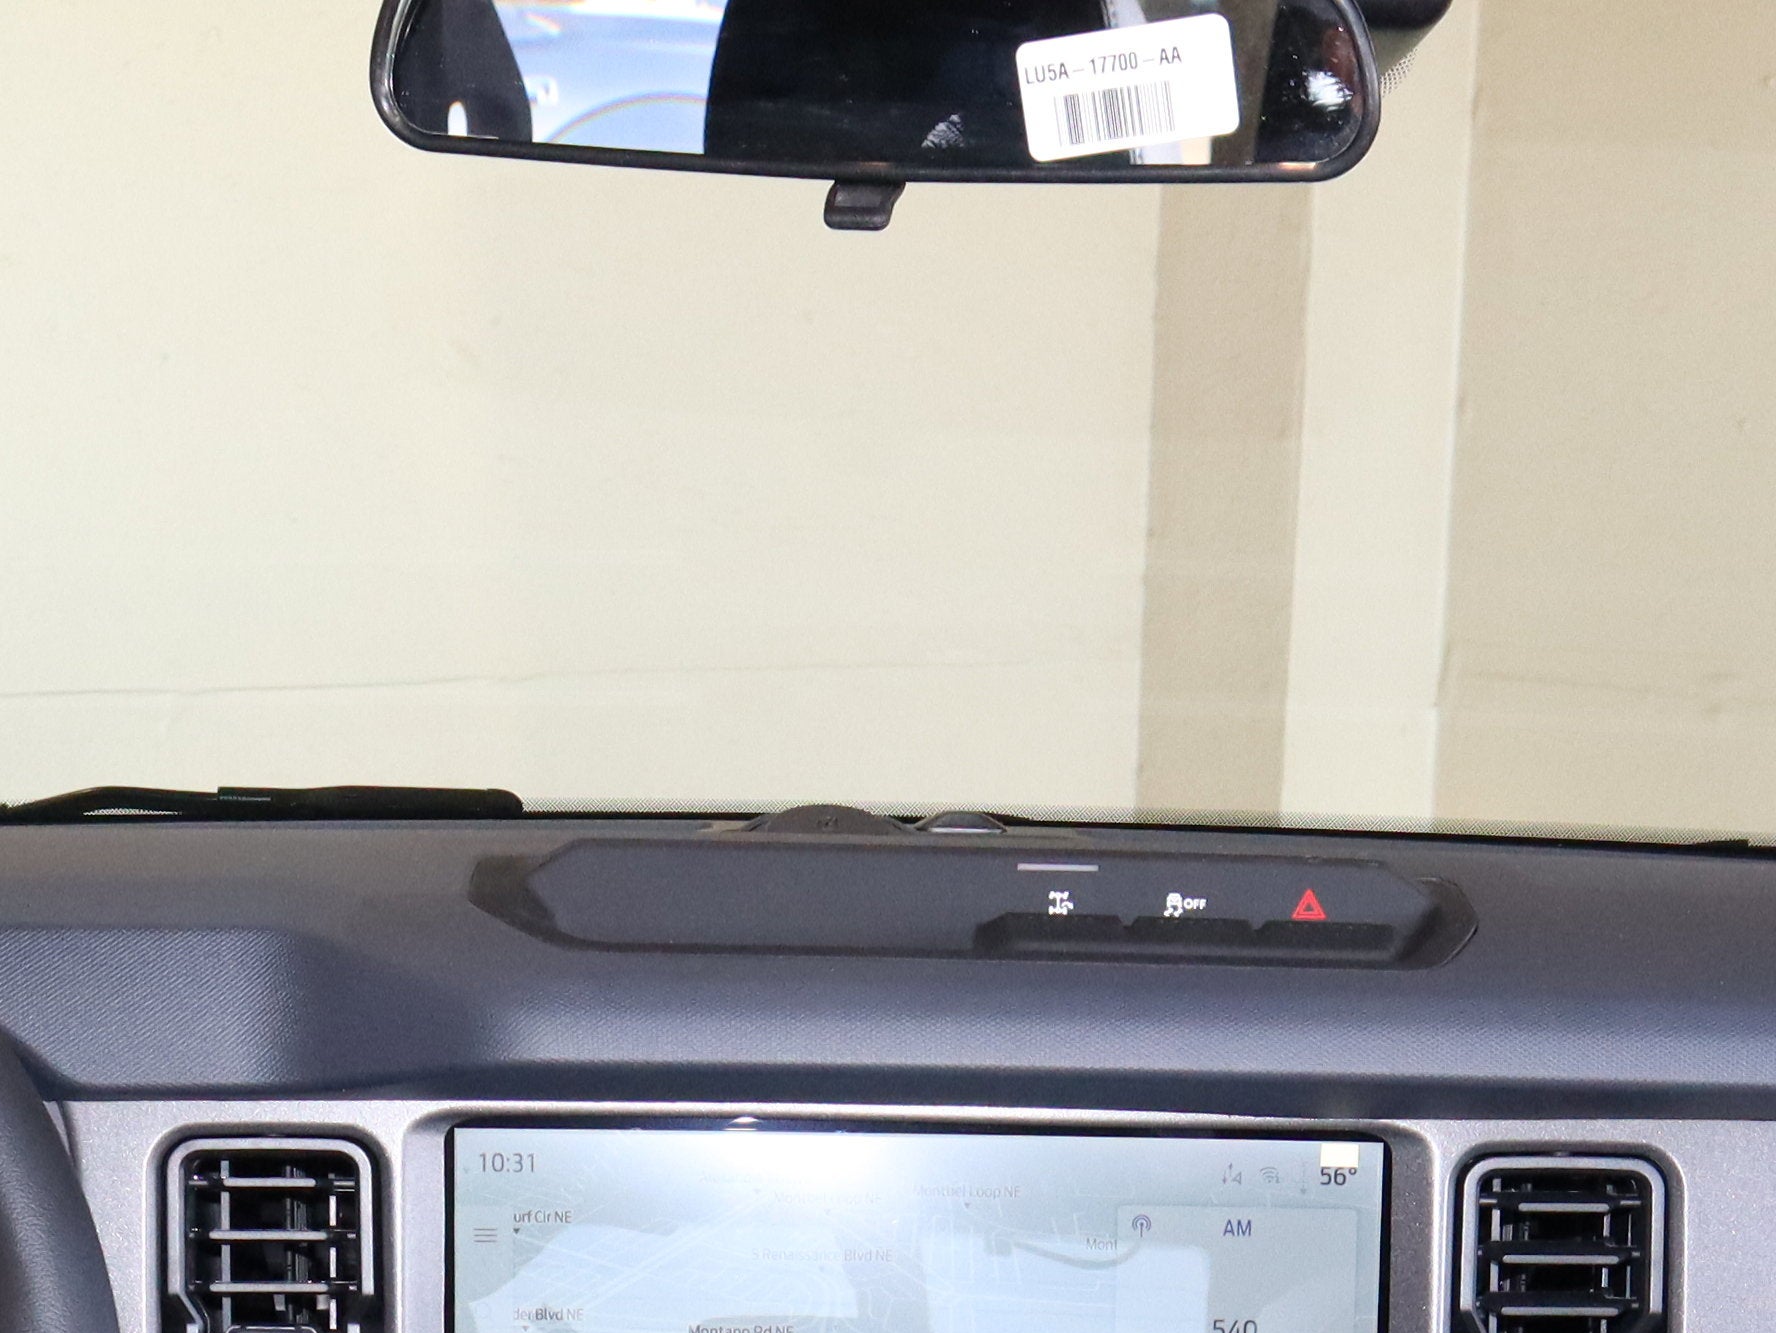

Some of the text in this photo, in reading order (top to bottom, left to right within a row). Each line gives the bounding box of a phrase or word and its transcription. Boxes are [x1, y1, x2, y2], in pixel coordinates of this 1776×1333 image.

[1183, 897, 1207, 910] OFF
[479, 1152, 537, 1174] 10:31
[1004, 1185, 1021, 1199] NE
[553, 1210, 572, 1224] NE
[1222, 1219, 1253, 1238] AM
[843, 1249, 873, 1263] Blvd
[875, 1249, 893, 1262] NE
[535, 1307, 564, 1322] Blvd
[566, 1308, 584, 1321] NE
